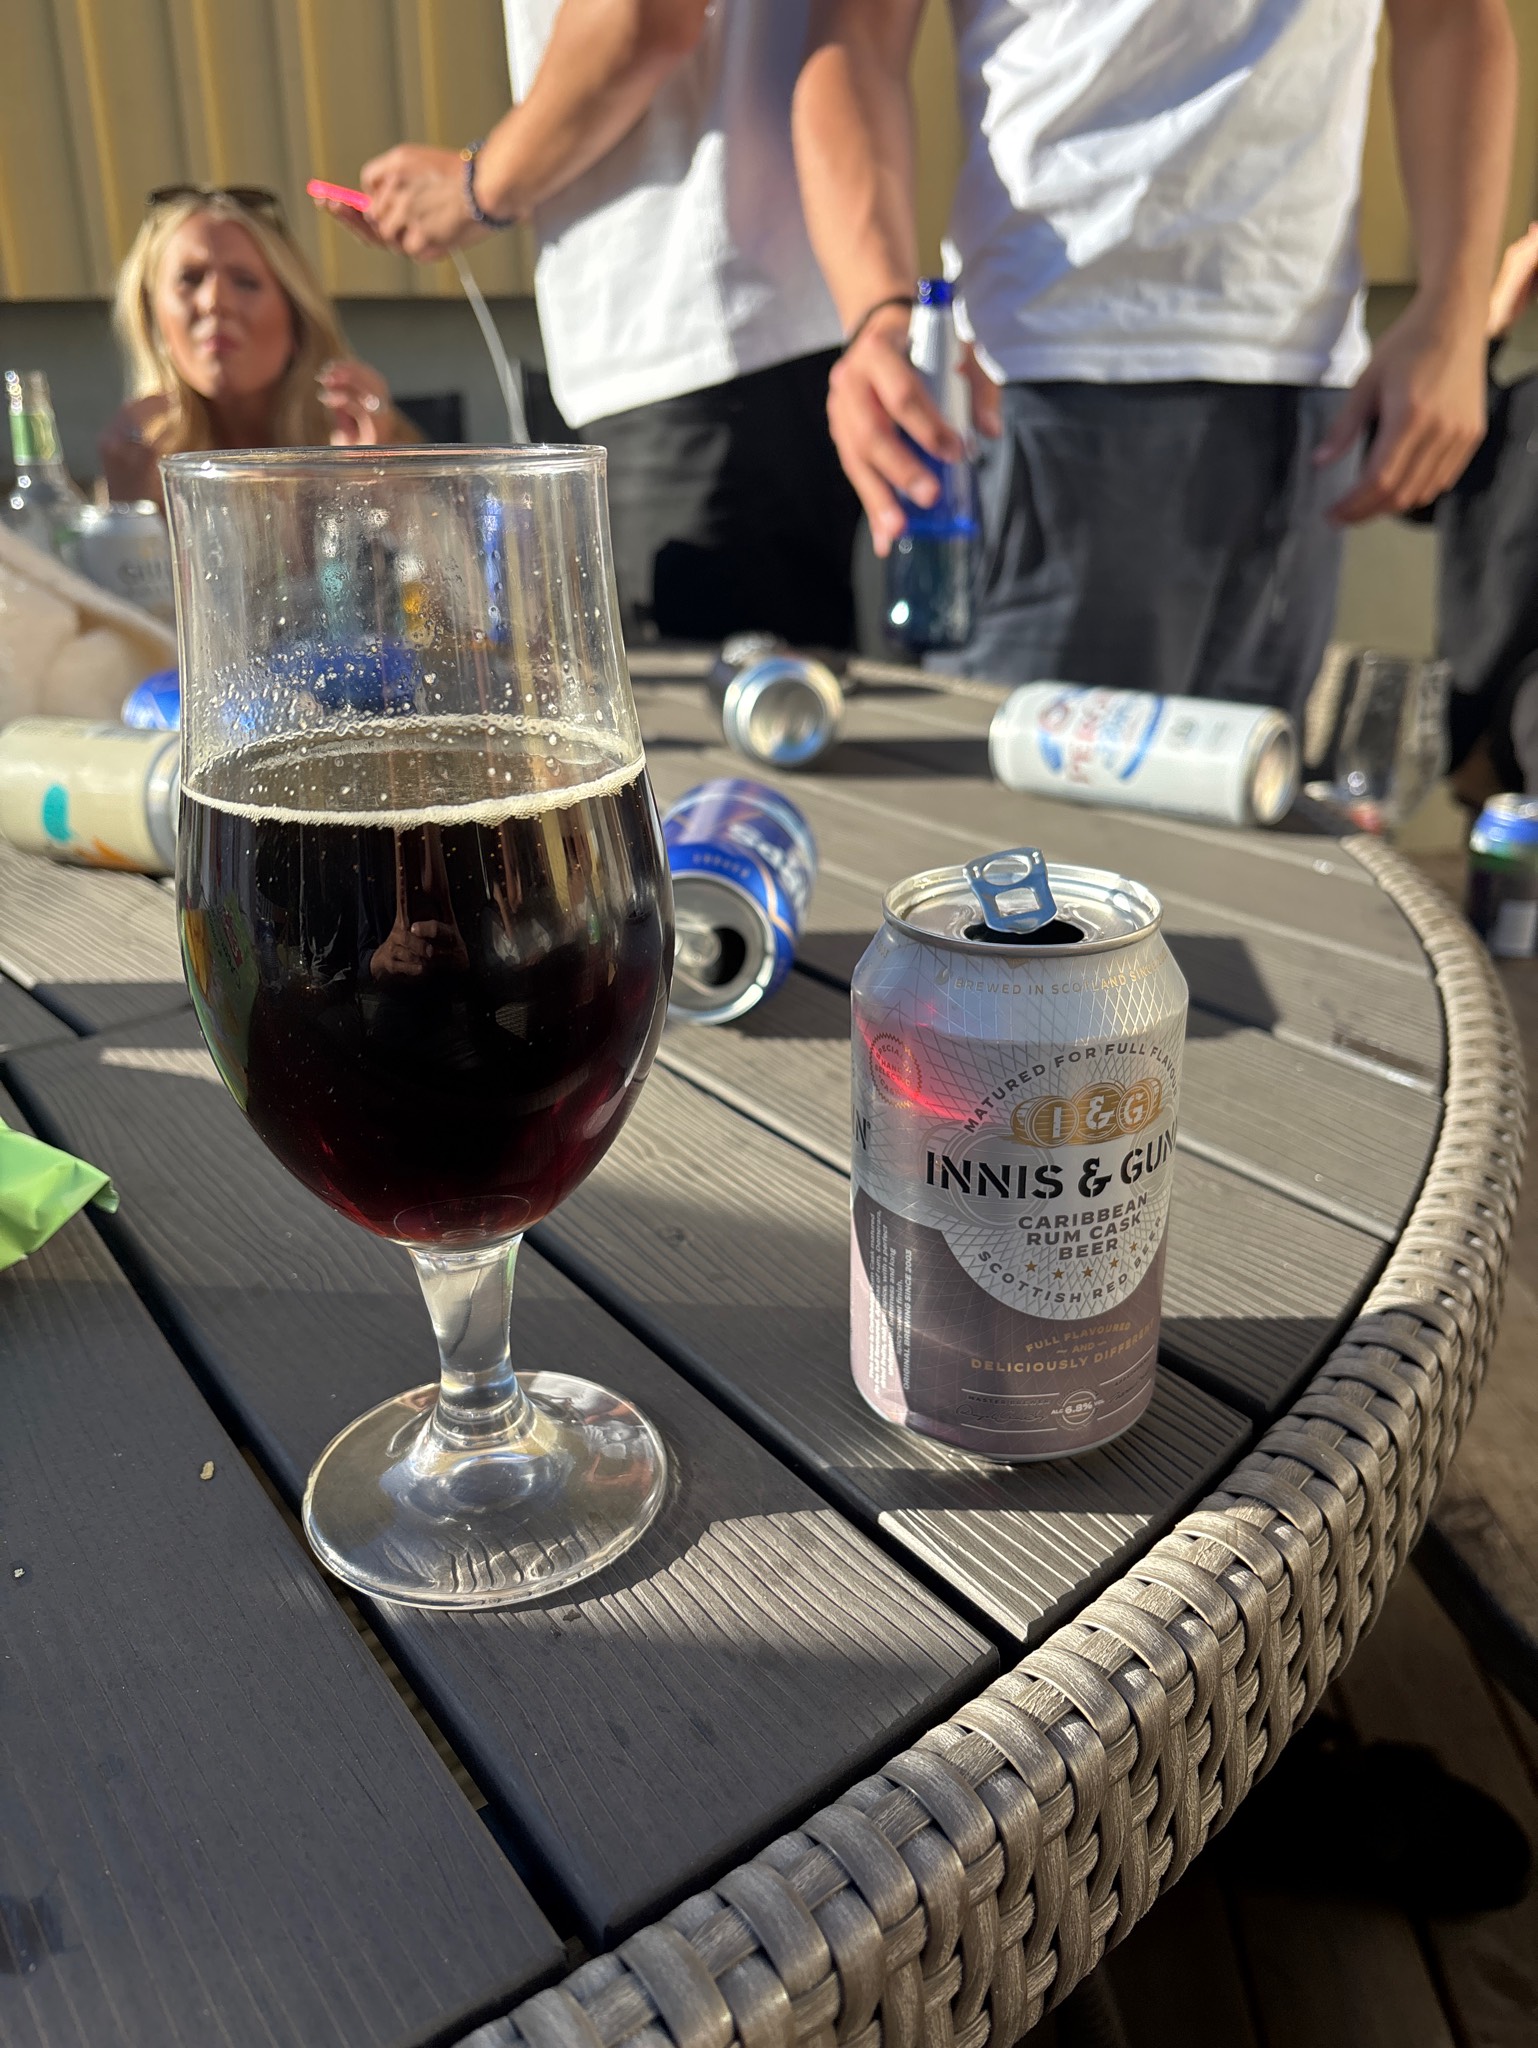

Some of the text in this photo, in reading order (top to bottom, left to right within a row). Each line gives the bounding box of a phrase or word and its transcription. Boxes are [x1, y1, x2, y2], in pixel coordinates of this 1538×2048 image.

[954, 978, 1022, 995] BREWED
[1029, 985, 1045, 995] IN
[1051, 974, 1127, 995] SCOTLAND
[963, 1064, 1047, 1134] MATURED
[1053, 1047, 1097, 1068] FOR
[1104, 1042, 1146, 1056] FULL
[1085, 1095, 1116, 1131] &
[1123, 1091, 1146, 1126] G
[925, 1150, 1065, 1200] INNIS
[1077, 1156, 1113, 1199] &
[1018, 1191, 1149, 1230] CARIBBEAN
[1026, 1209, 1143, 1247] RUM CASK
[1058, 1237, 1119, 1261] BEER
[977, 1250, 1082, 1304] SCOTTISH
[1092, 1272, 1128, 1300] RED
[903, 1248, 912, 1390] ORIGINAL BREWING SINCE 2003
[1024, 1321, 1133, 1353] FULL FLAVOURED
[970, 1356, 1089, 1373] DELICIOUSLY
[1071, 1342, 1096, 1354] AND
[1064, 1401, 1094, 1415] 6.8%
